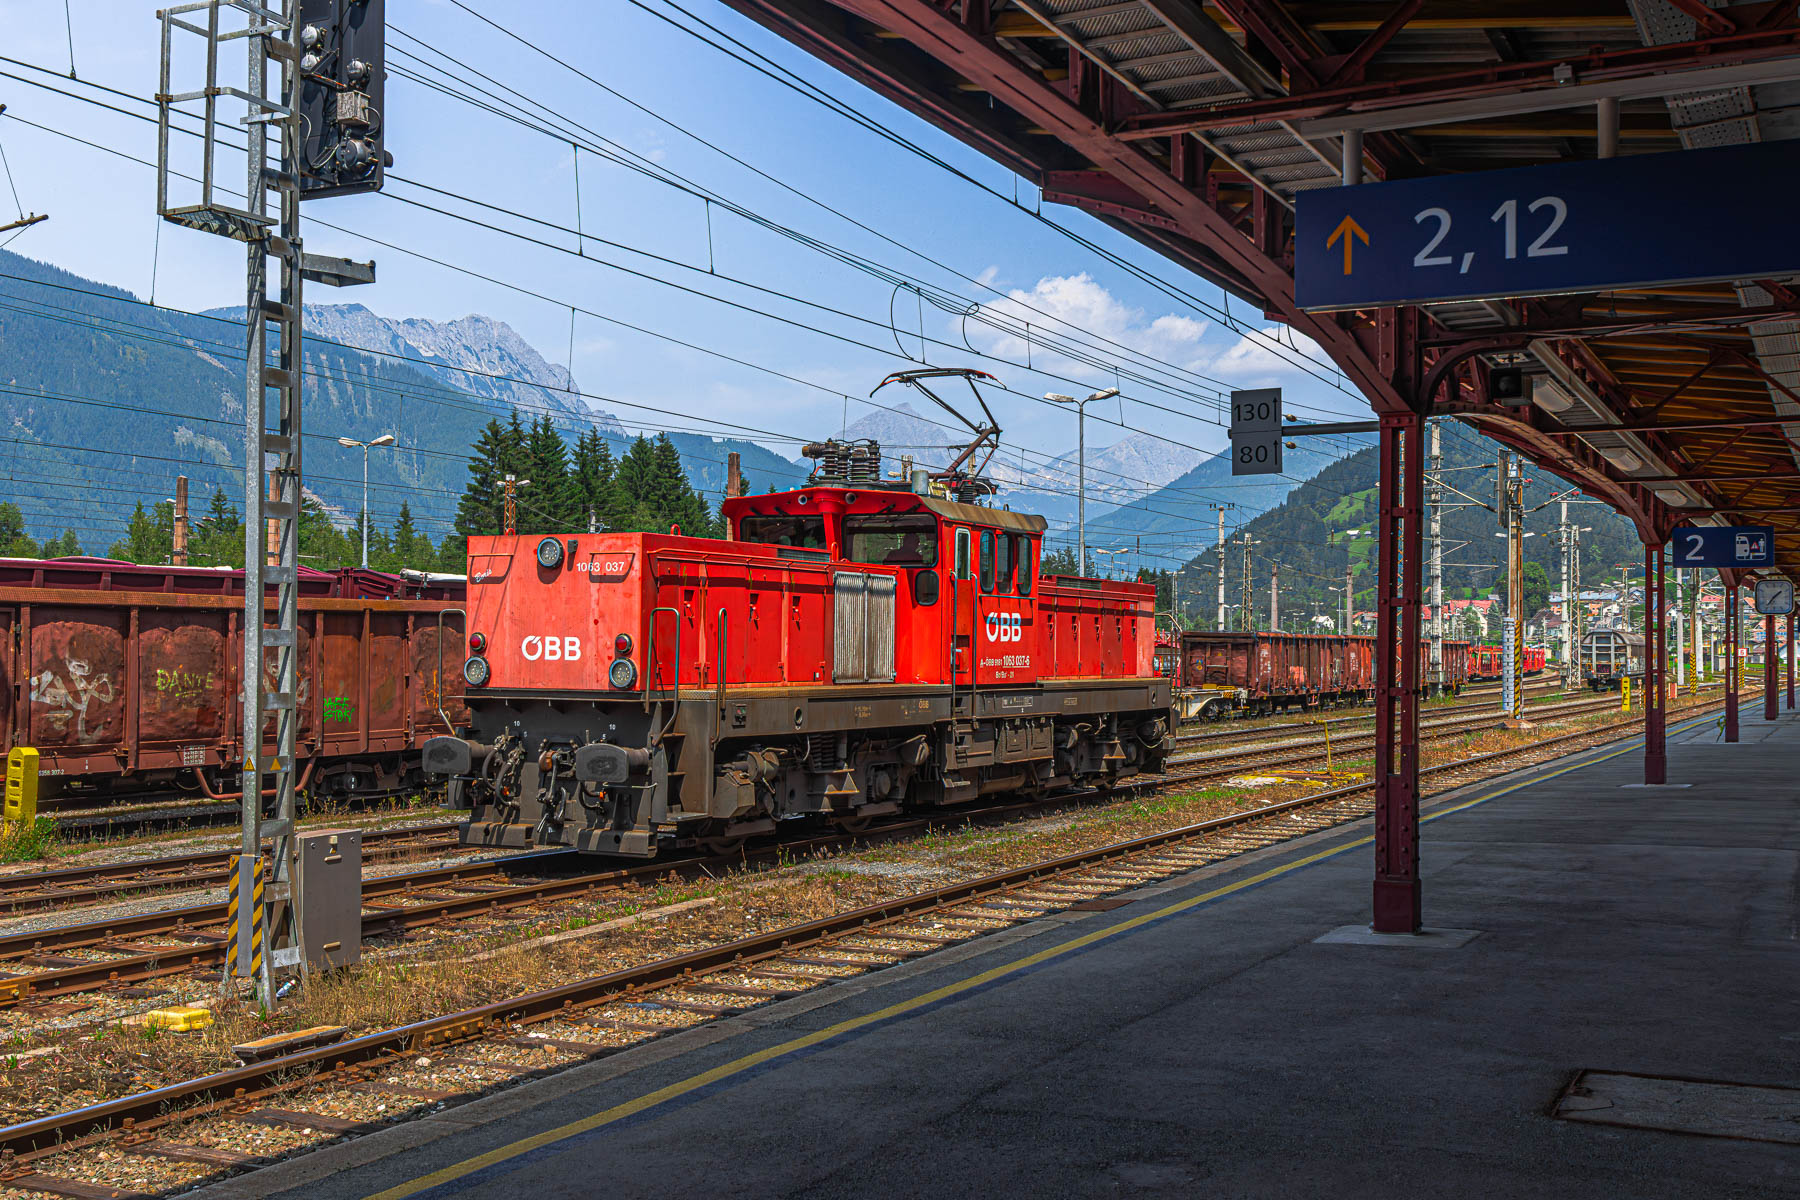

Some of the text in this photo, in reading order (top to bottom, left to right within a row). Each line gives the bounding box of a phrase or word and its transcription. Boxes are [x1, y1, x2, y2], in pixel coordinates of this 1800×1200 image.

[1413, 196, 1568, 275] 2, 12
[1234, 401, 1271, 422] 130
[1239, 444, 1268, 465] 80
[1685, 534, 1704, 561] 2
[576, 561, 625, 573] 1063 037
[986, 612, 1022, 643] ÖBB
[521, 635, 581, 662] ÖBB
[1003, 655, 1015, 666] 1063
[609, 723, 616, 731] 10
